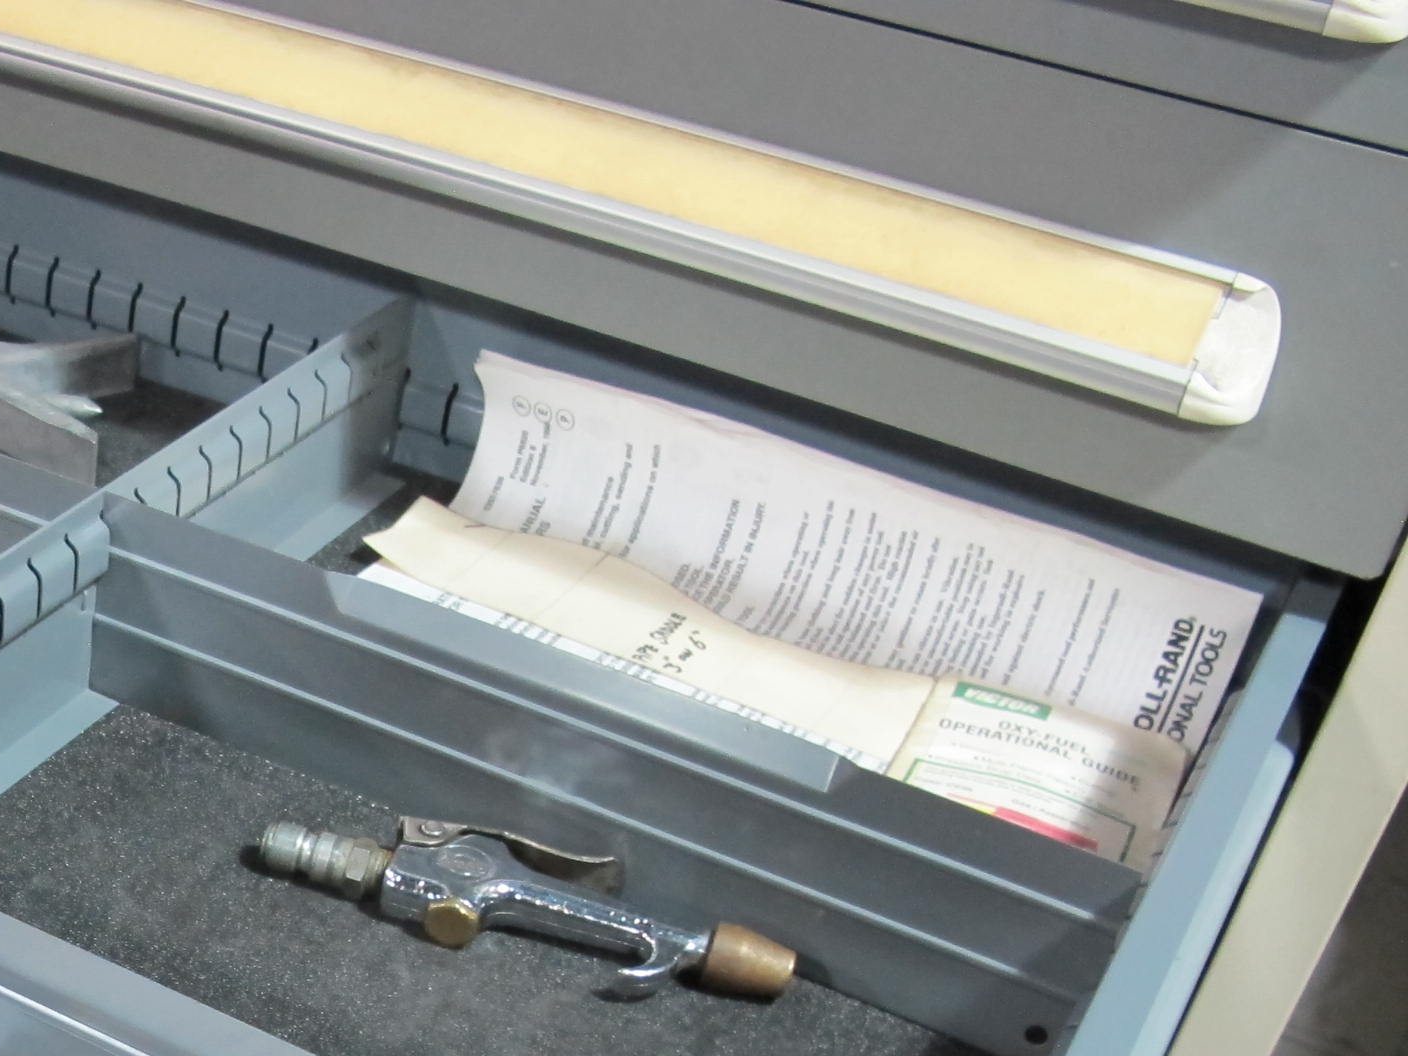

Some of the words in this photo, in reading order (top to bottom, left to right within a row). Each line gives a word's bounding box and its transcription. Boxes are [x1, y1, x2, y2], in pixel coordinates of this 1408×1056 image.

[708, 498, 740, 570] INFORMATION
[725, 554, 749, 593] RESULT
[964, 688, 1040, 714] VICTOR
[1165, 687, 1203, 741] ONAL
[1187, 627, 1227, 689] TOOLS
[939, 718, 1072, 761] OPERATIONAL
[1082, 758, 1141, 785] GUIDE
[997, 720, 1098, 756] OXY-FUEL
